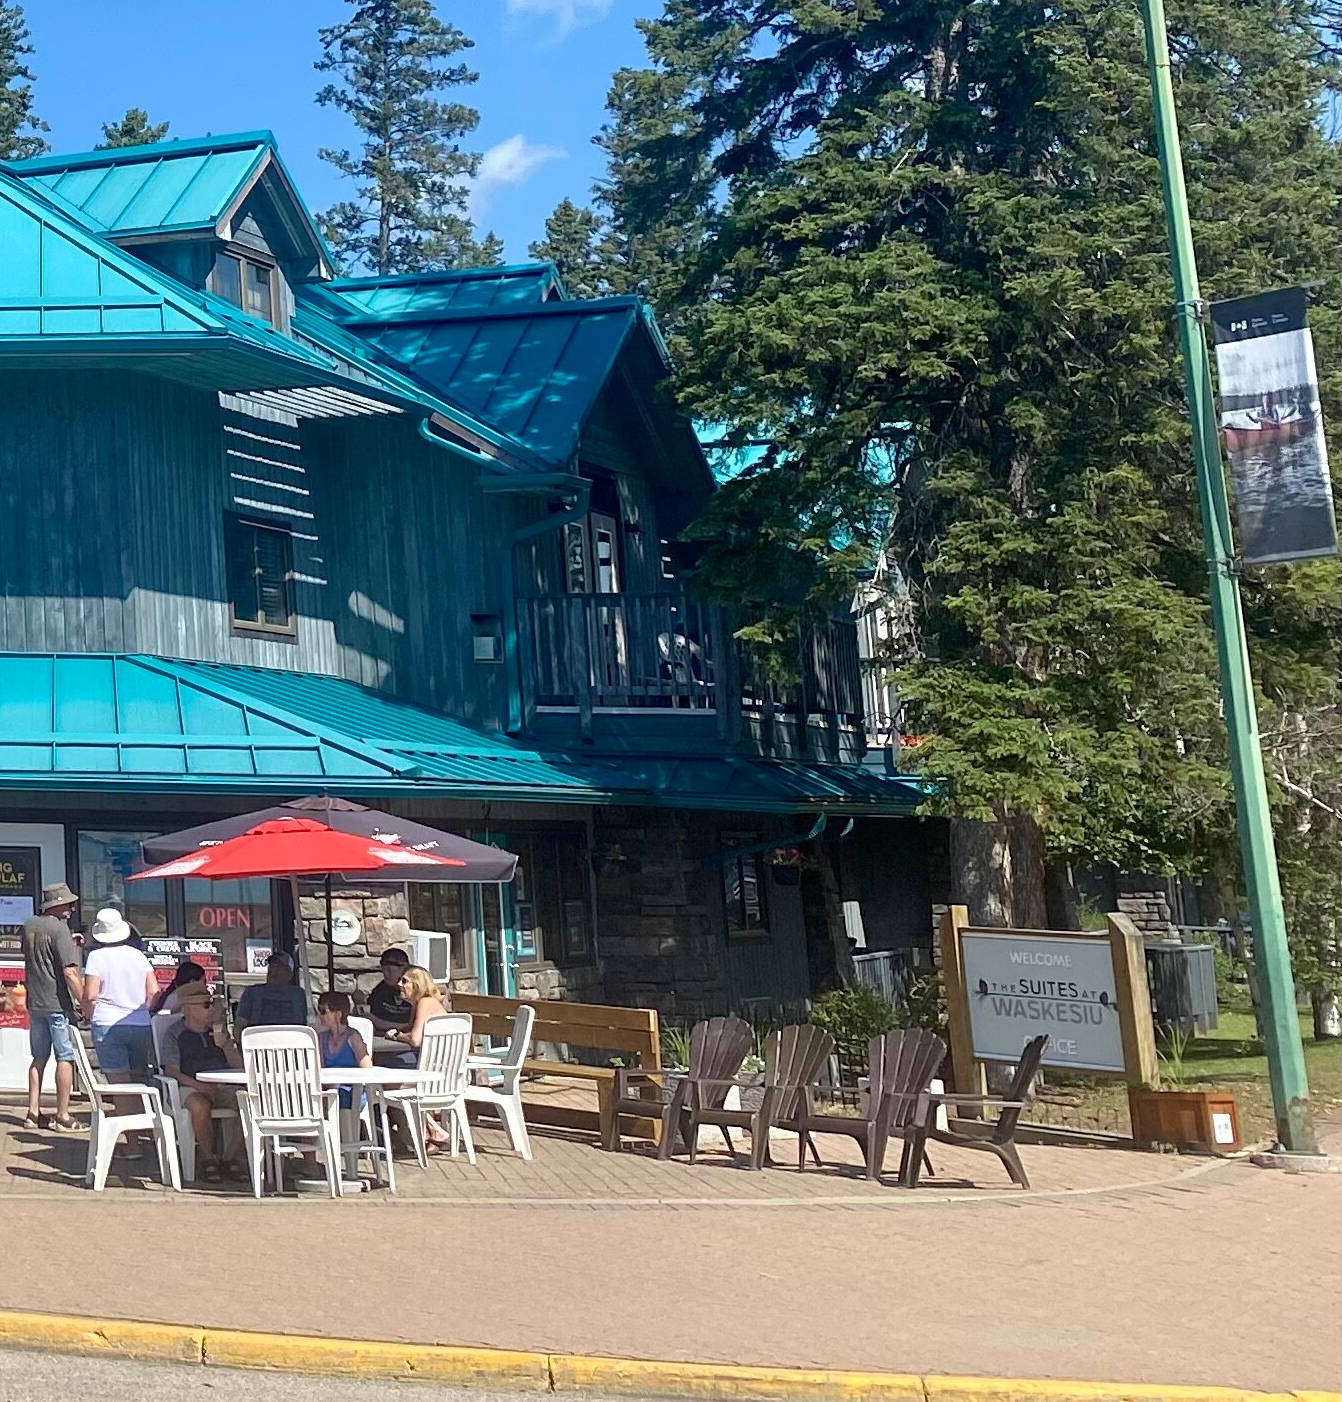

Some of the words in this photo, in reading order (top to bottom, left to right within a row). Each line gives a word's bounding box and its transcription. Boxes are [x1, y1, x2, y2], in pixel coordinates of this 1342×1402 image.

[199, 907, 250, 928] OPEN
[1009, 950, 1072, 967] WELCOME
[991, 982, 1016, 993] THE
[1019, 979, 1078, 998] SUITES
[1081, 989, 1097, 1000] AT
[991, 997, 1103, 1026] WASKESIU
[1023, 1035, 1077, 1055] OICE
